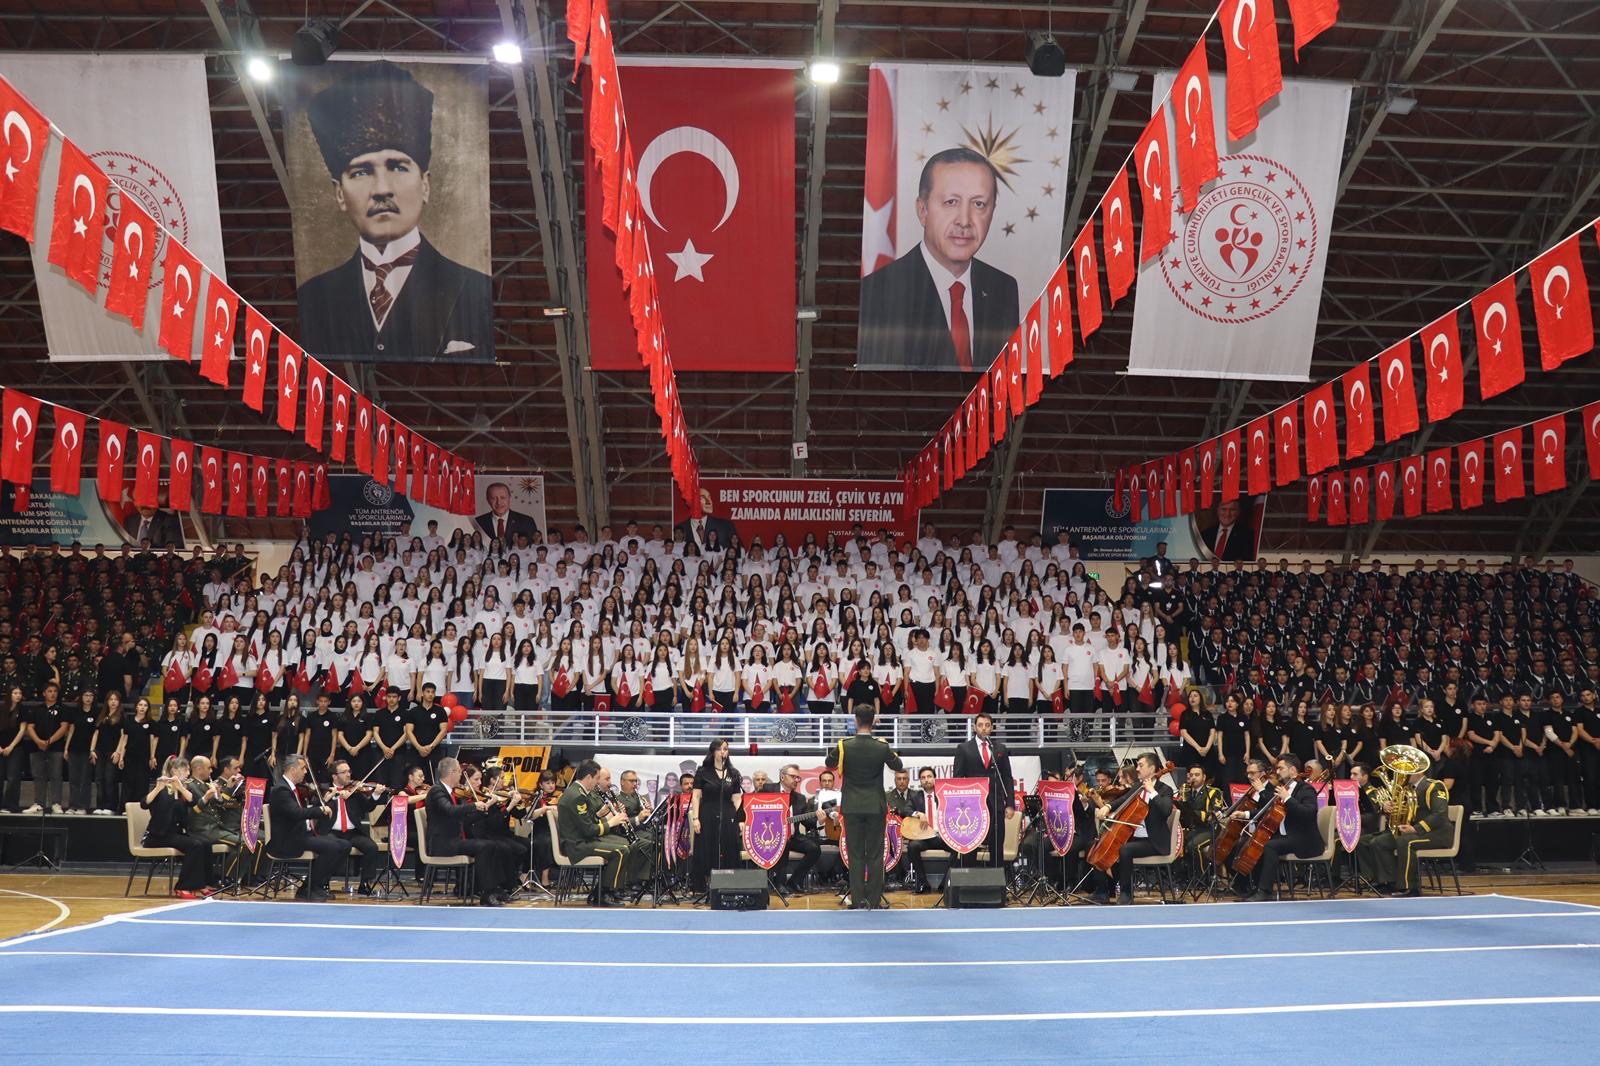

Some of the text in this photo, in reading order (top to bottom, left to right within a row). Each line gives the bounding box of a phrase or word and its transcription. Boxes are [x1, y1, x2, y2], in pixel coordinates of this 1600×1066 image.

[139, 189, 150, 201] VE
[1187, 187, 1289, 292] TÜRKİYE CUMHURİYETİ GENÇLİK VE SPOR BAKANLIĞI
[720, 487, 904, 507] BEN SPORCUNUN ZEKİ, ÇEVİK VE AYN
[730, 505, 896, 522] ZAMANDA AHLAKLISINI SEVERİM.
[502, 756, 544, 773] SPOR
